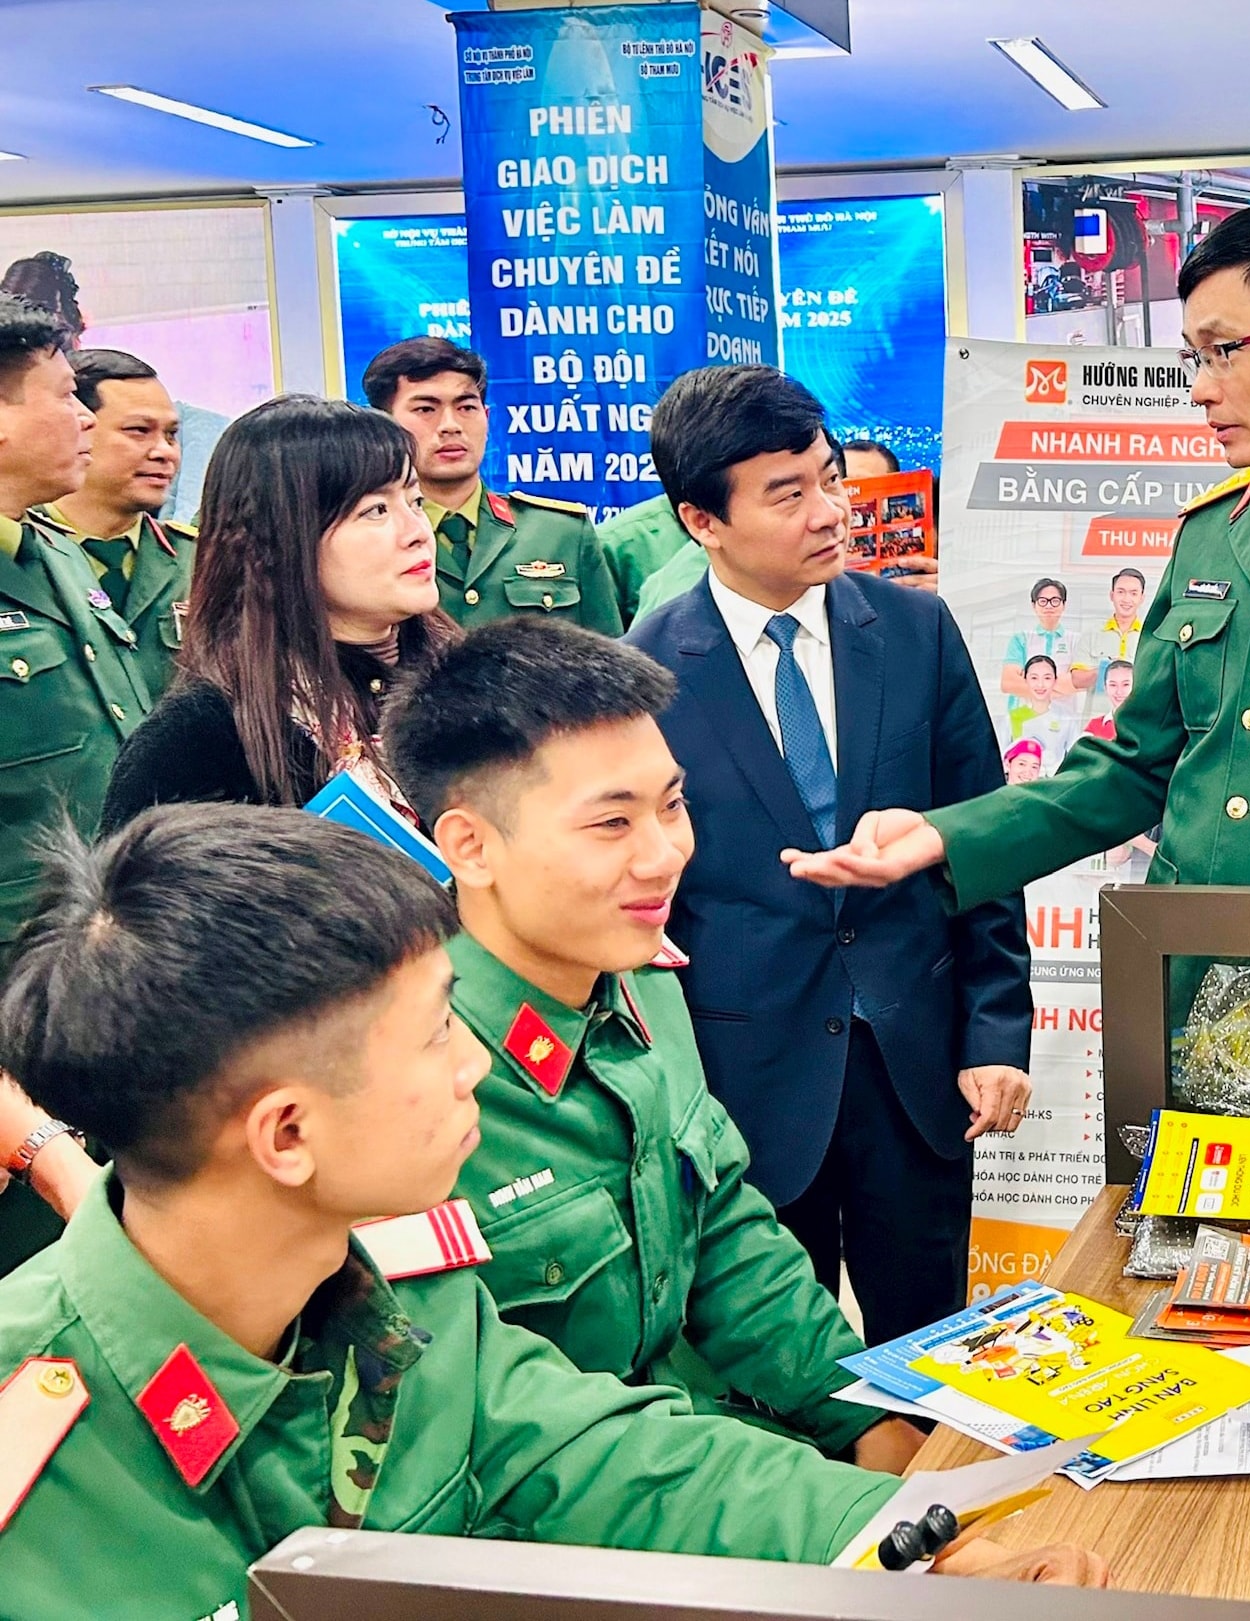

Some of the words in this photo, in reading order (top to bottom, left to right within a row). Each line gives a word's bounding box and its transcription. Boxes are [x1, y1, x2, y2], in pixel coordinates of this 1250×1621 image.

[529, 97, 632, 137] PHIÊN
[497, 158, 576, 189] GIAO
[588, 154, 669, 190] DỊCH
[503, 201, 581, 242] VIỆC
[593, 198, 665, 235] LÀM
[704, 184, 738, 227] ỎNG
[742, 197, 769, 238] VẤN
[491, 247, 624, 287] CHUYÊN
[637, 246, 682, 285] ĐỀ
[734, 239, 759, 278] NỐI
[500, 302, 599, 337] DÀNH
[607, 305, 674, 335] CHO
[737, 285, 769, 324] TIẾP
[807, 310, 852, 328] 2025
[707, 332, 762, 365] DOANH
[533, 349, 583, 390] BỘ
[594, 348, 646, 389] ĐỘI
[1083, 361, 1138, 388] HƯỚNG
[507, 397, 601, 433] XUẤT
[609, 402, 654, 432] NG
[1082, 394, 1131, 408] CHUYÊN
[1135, 396, 1180, 411] NGHIỆP
[1031, 431, 1121, 456] NHANH
[1128, 434, 1164, 457] RA
[1171, 436, 1226, 460] NGH
[508, 448, 594, 482] NĂM
[605, 452, 661, 482] 202
[998, 465, 1087, 505] BẰNG
[1099, 471, 1163, 506] CẤP
[1099, 530, 1136, 546] THU
[1060, 965, 1084, 977] ỨNG
[1087, 967, 1101, 978] NG
[1069, 1008, 1103, 1032] NG
[974, 1149, 996, 1160] UẢN
[1000, 1151, 1015, 1163] TRỊ
[1018, 1153, 1025, 1161] &
[1029, 1150, 1056, 1162] PHÁT
[1060, 1150, 1089, 1163] TRIỂN
[974, 1170, 994, 1182] HÓA
[998, 1172, 1020, 1183] HỌC
[1024, 1171, 1053, 1183] DÀNH
[1056, 1175, 1078, 1184] CHO
[1082, 1174, 1102, 1185] TRẺ
[973, 1189, 994, 1202] HÓA
[997, 1193, 1020, 1204] HỌC
[1023, 1191, 1052, 1204] DÀNH
[1055, 1194, 1078, 1205] CHO
[1081, 1196, 1095, 1205] PH
[968, 1244, 1016, 1274] ỔNG
[1022, 1249, 1053, 1275] ĐÀ
[1125, 1368, 1179, 1395] SÁNG
[1085, 1394, 1128, 1413] TẠO
